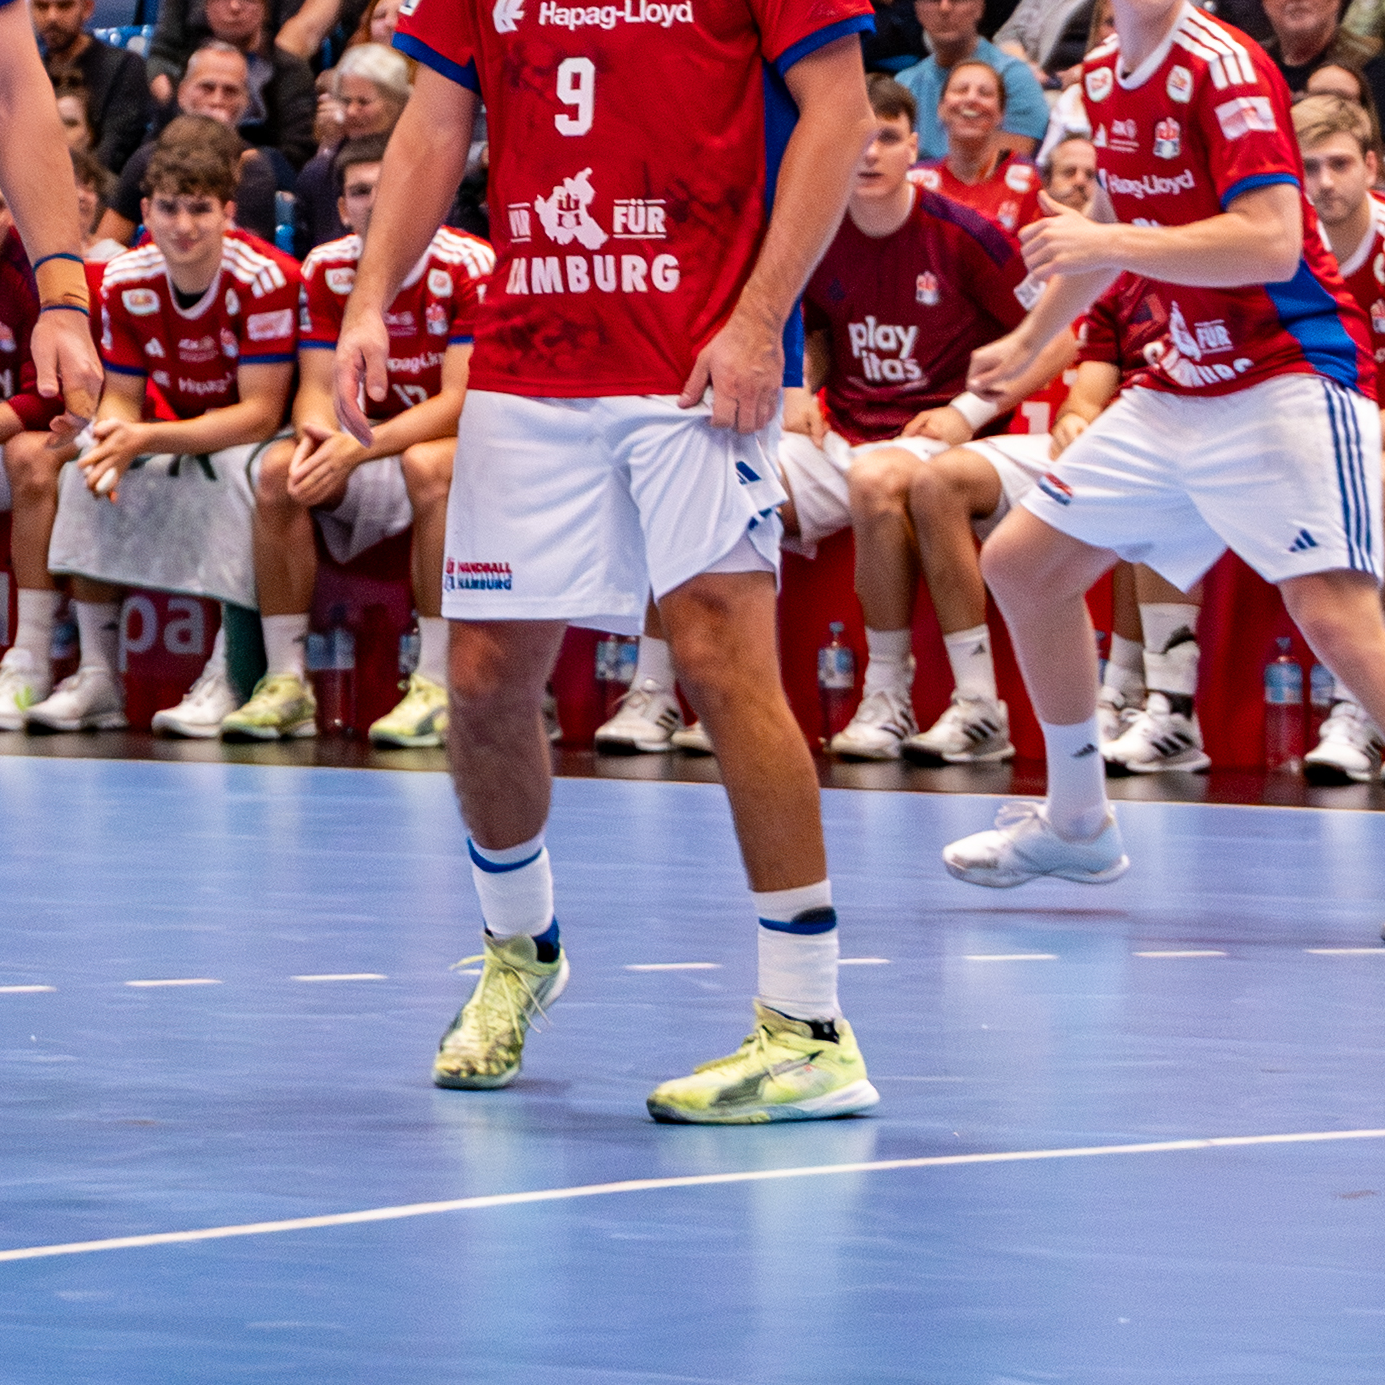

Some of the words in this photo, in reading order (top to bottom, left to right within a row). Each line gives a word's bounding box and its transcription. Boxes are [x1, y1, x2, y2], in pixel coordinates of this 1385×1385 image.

[554, 56, 596, 137] 9
[613, 200, 667, 236] FÜR
[506, 255, 681, 296] AMBURG
[848, 315, 918, 359] play
[861, 351, 923, 382] itas
